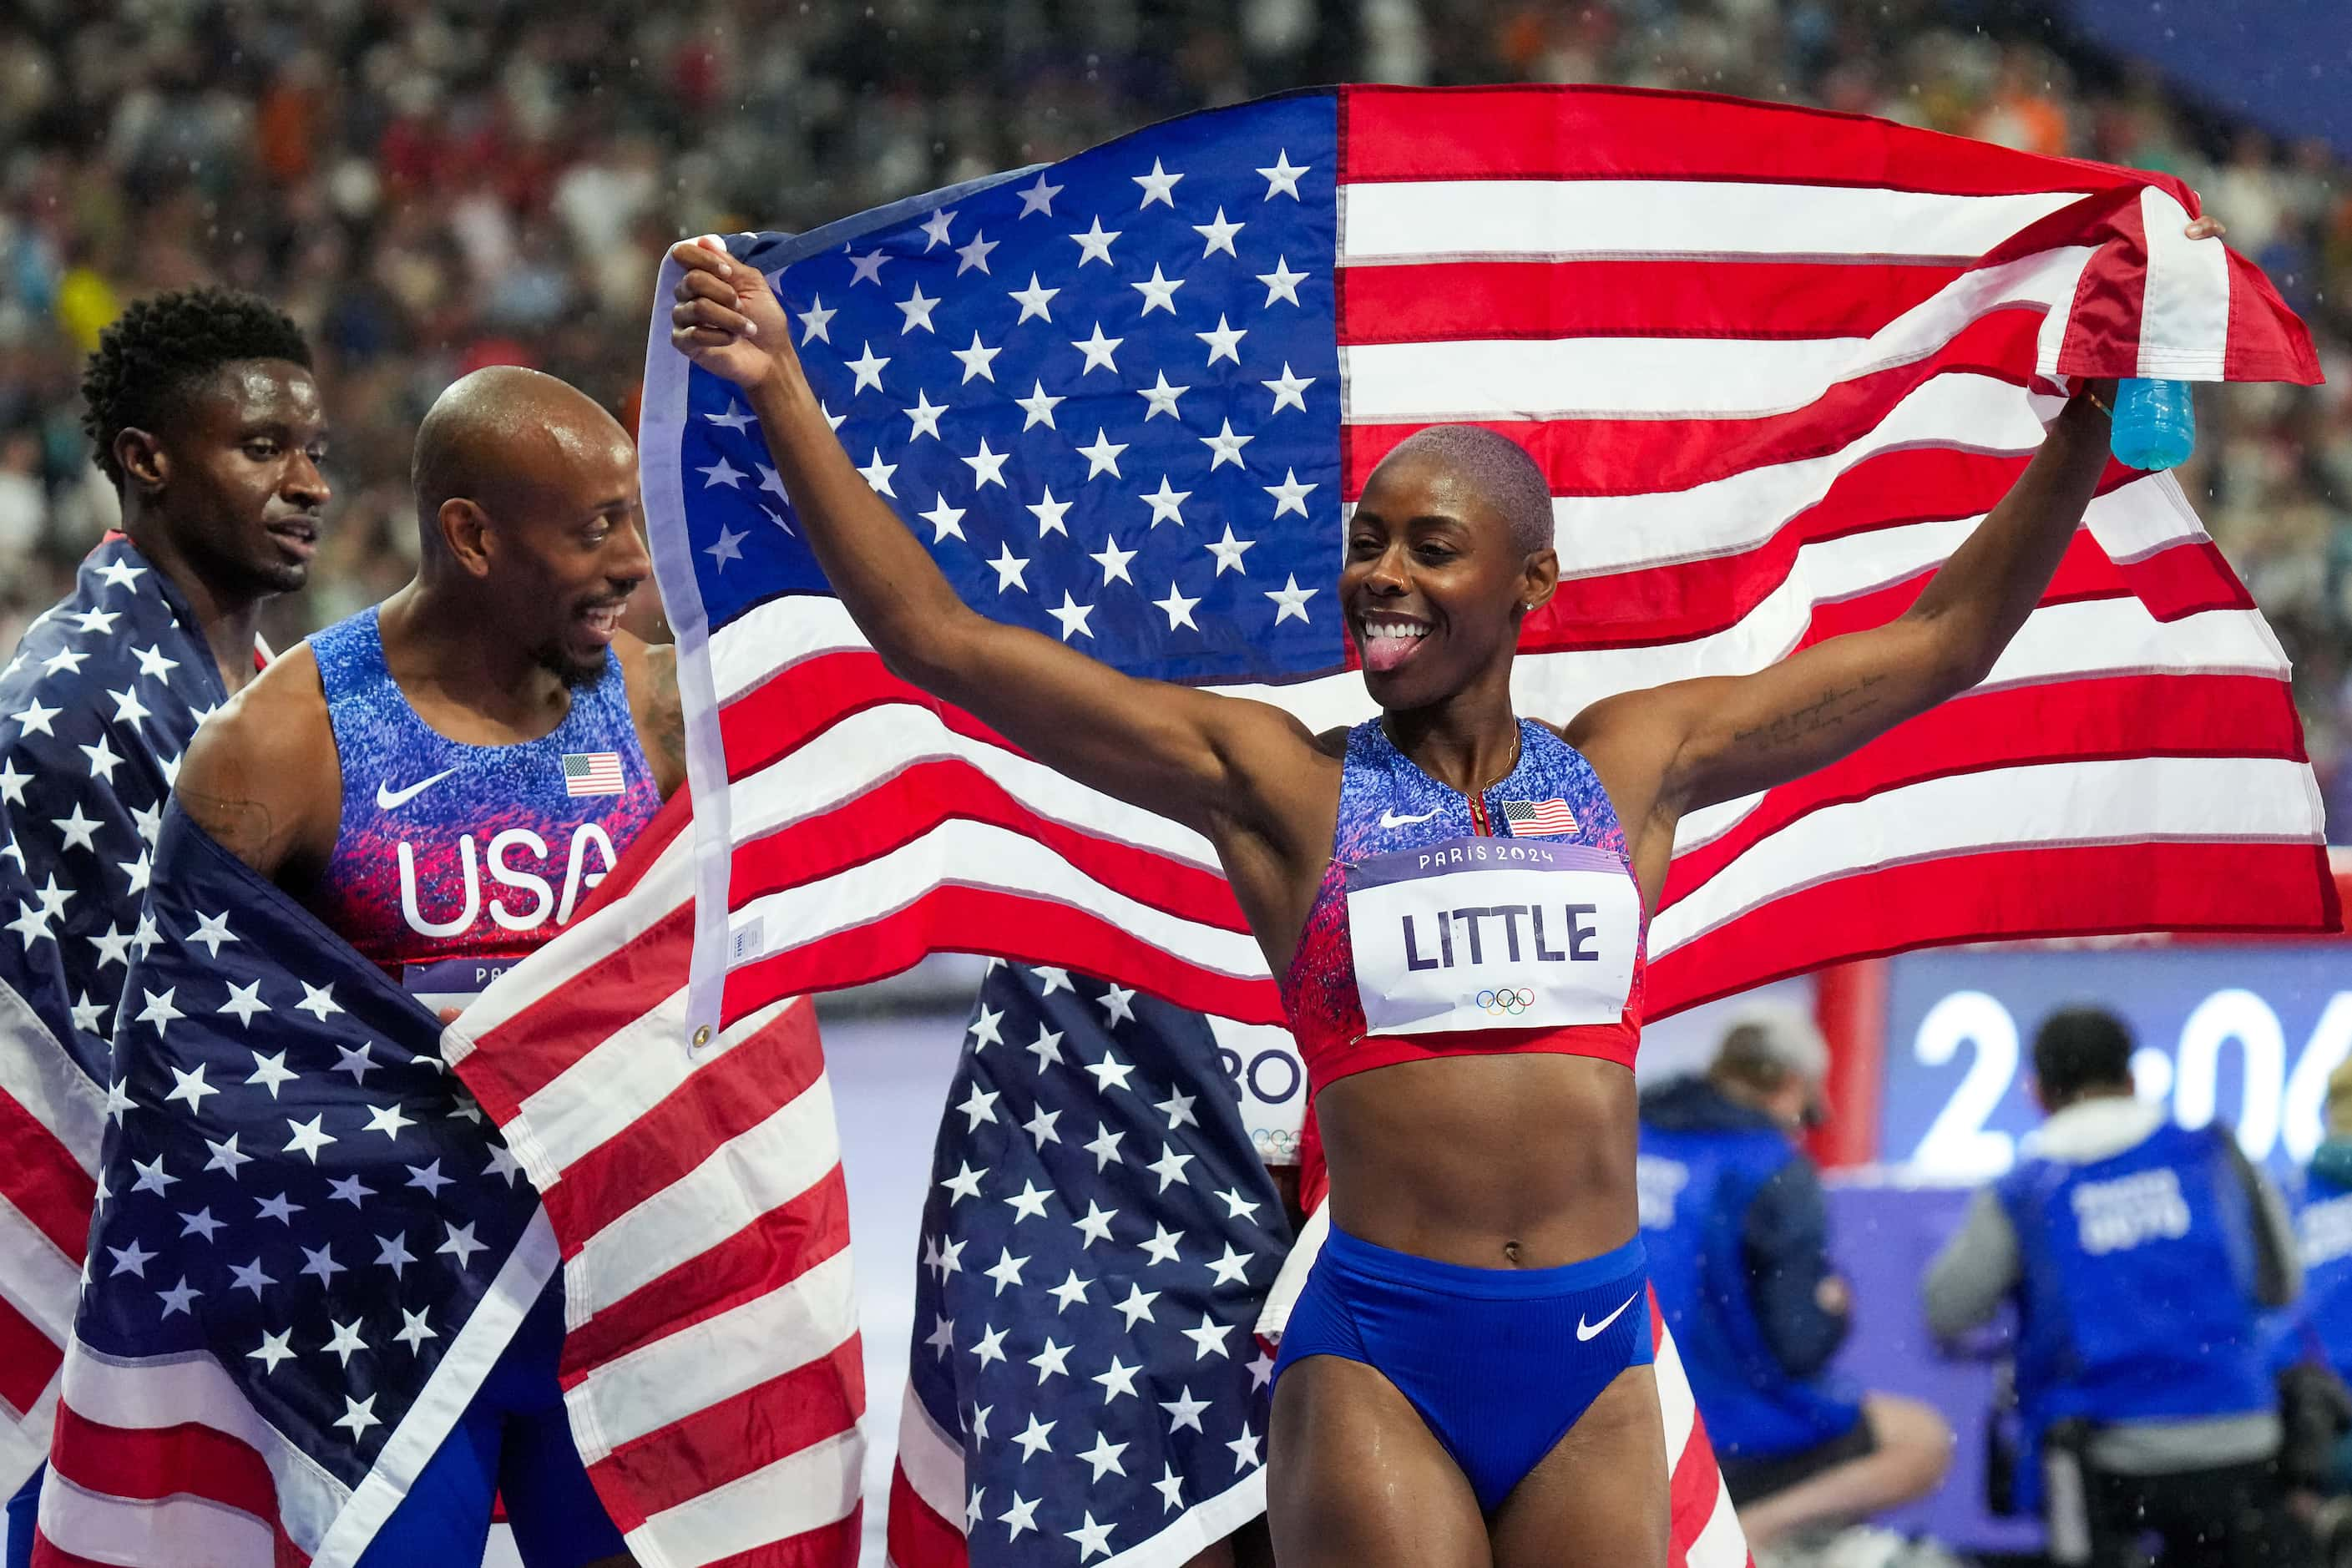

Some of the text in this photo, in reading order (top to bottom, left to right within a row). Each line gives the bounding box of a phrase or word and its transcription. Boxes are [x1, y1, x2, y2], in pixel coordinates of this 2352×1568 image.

[397, 823, 618, 937] USA
[1495, 846, 1554, 862] 2024
[1403, 903, 1599, 972] LITTLE
